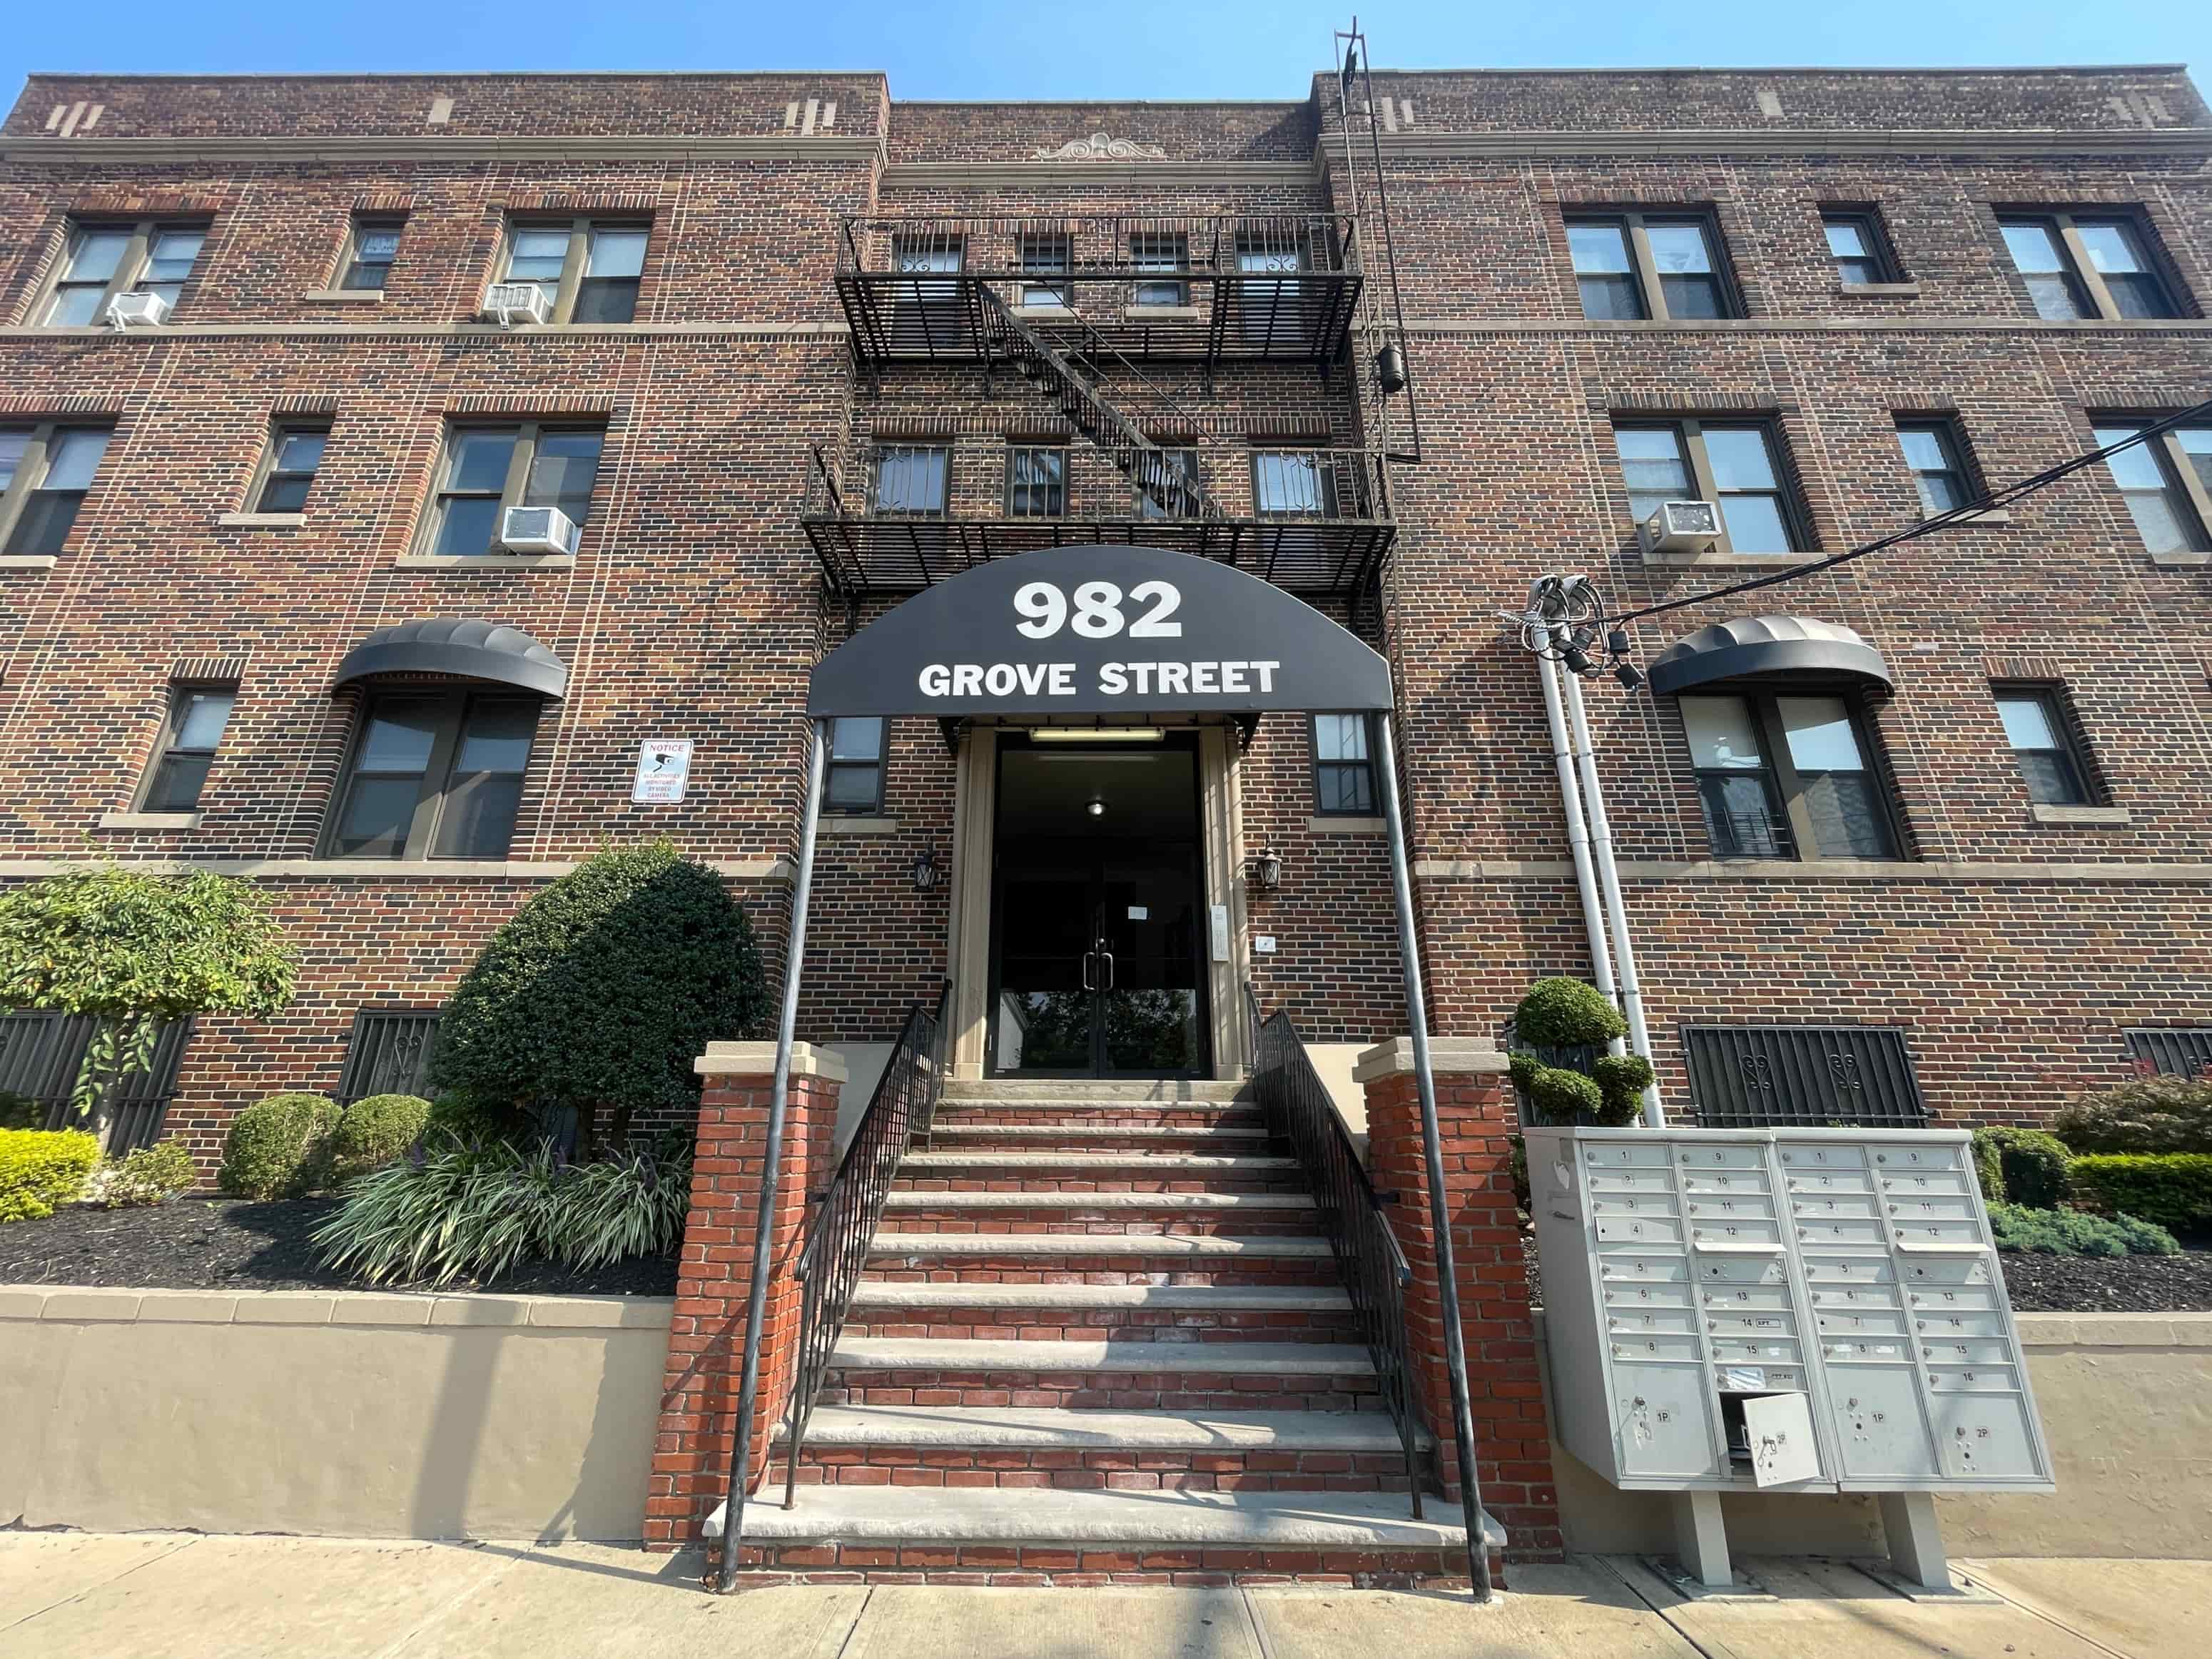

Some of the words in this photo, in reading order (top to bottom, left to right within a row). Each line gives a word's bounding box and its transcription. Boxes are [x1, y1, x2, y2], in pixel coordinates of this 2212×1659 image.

[1013, 581, 1182, 639] 982
[918, 663, 1077, 696] GROVE
[1098, 661, 1280, 695] STREET
[1722, 1202, 1731, 1210] 11
[1737, 1292, 1747, 1301] 13
[1944, 1292, 1954, 1301] 13
[1747, 1345, 1757, 1354] 15
[1957, 1345, 1967, 1354] 15
[1964, 1373, 1974, 1381] 16
[1658, 1412, 1668, 1421] 1P
[1872, 1414, 1884, 1422] 1P
[1977, 1429, 1988, 1439] 2P
